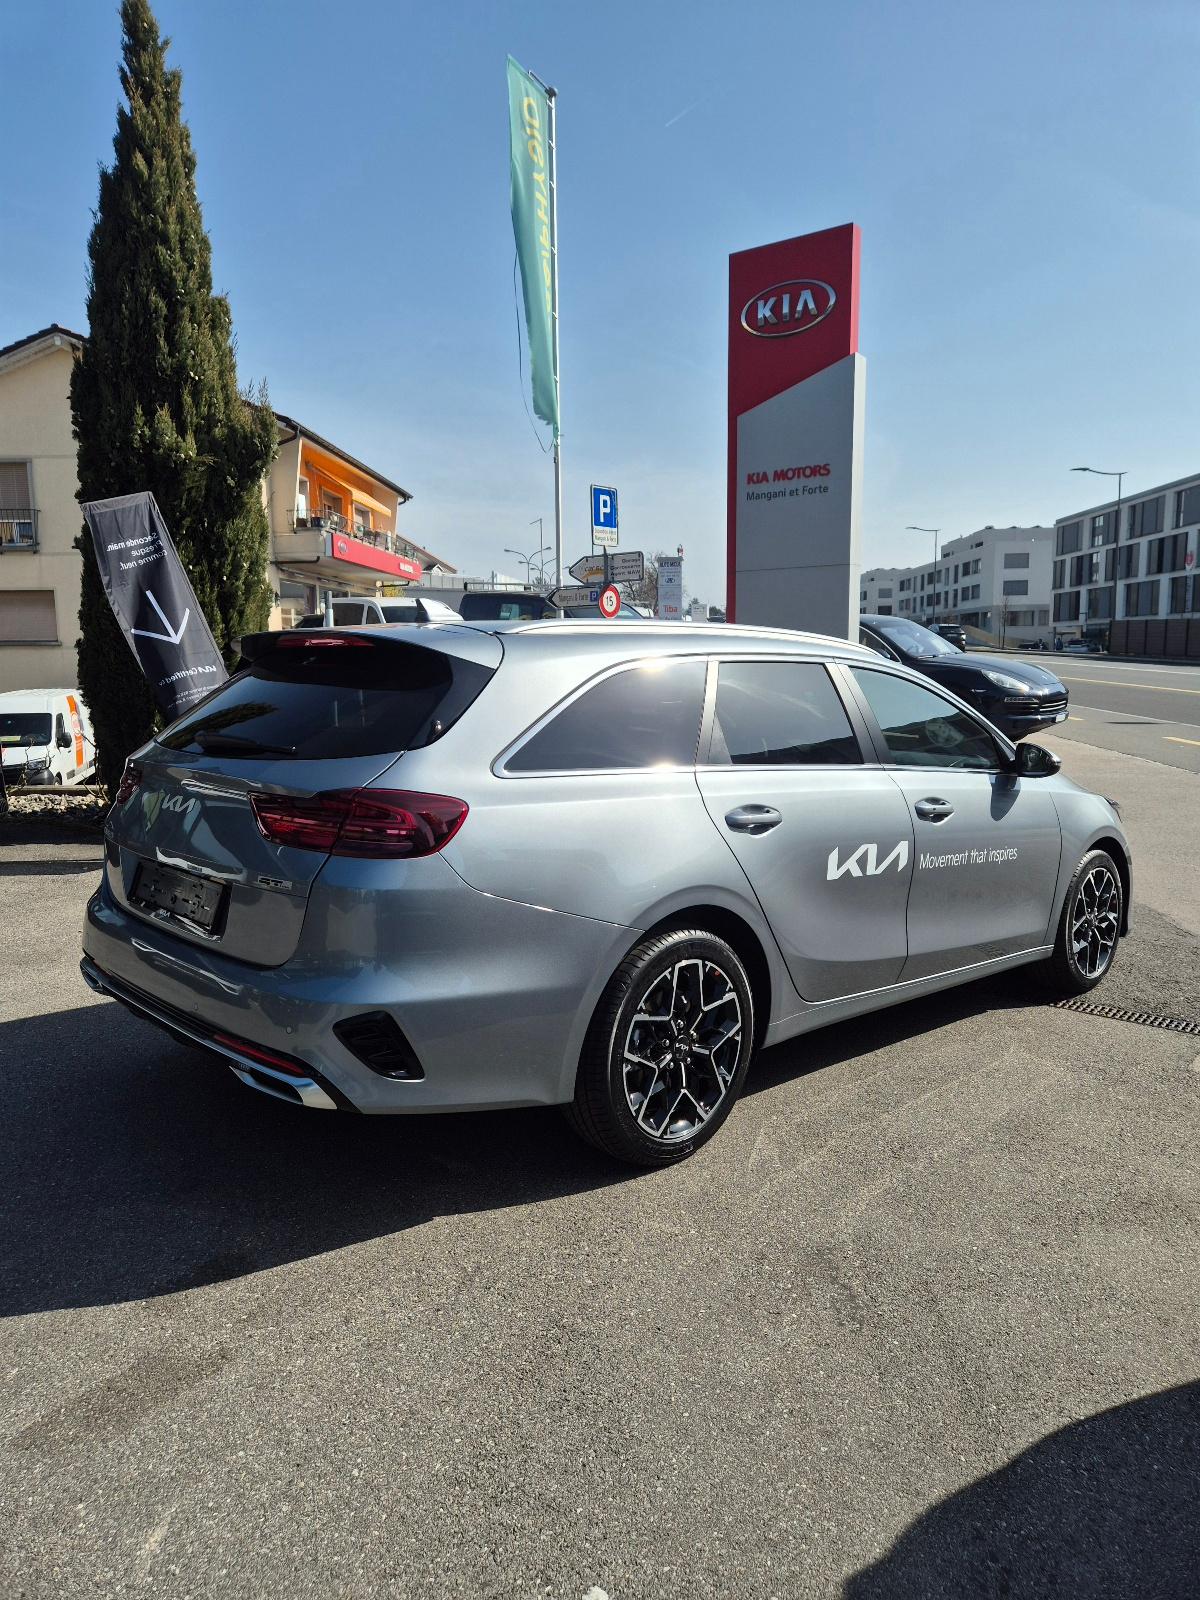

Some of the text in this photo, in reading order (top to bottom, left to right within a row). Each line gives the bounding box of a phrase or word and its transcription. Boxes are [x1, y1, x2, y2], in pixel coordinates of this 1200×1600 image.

[757, 289, 818, 327] KIA
[747, 463, 831, 485] KIA MOTORS
[746, 485, 829, 502] Mangani et Forte
[600, 494, 611, 523] P
[606, 596, 614, 606] 15
[827, 840, 1018, 881] KIA Movement that inspires
